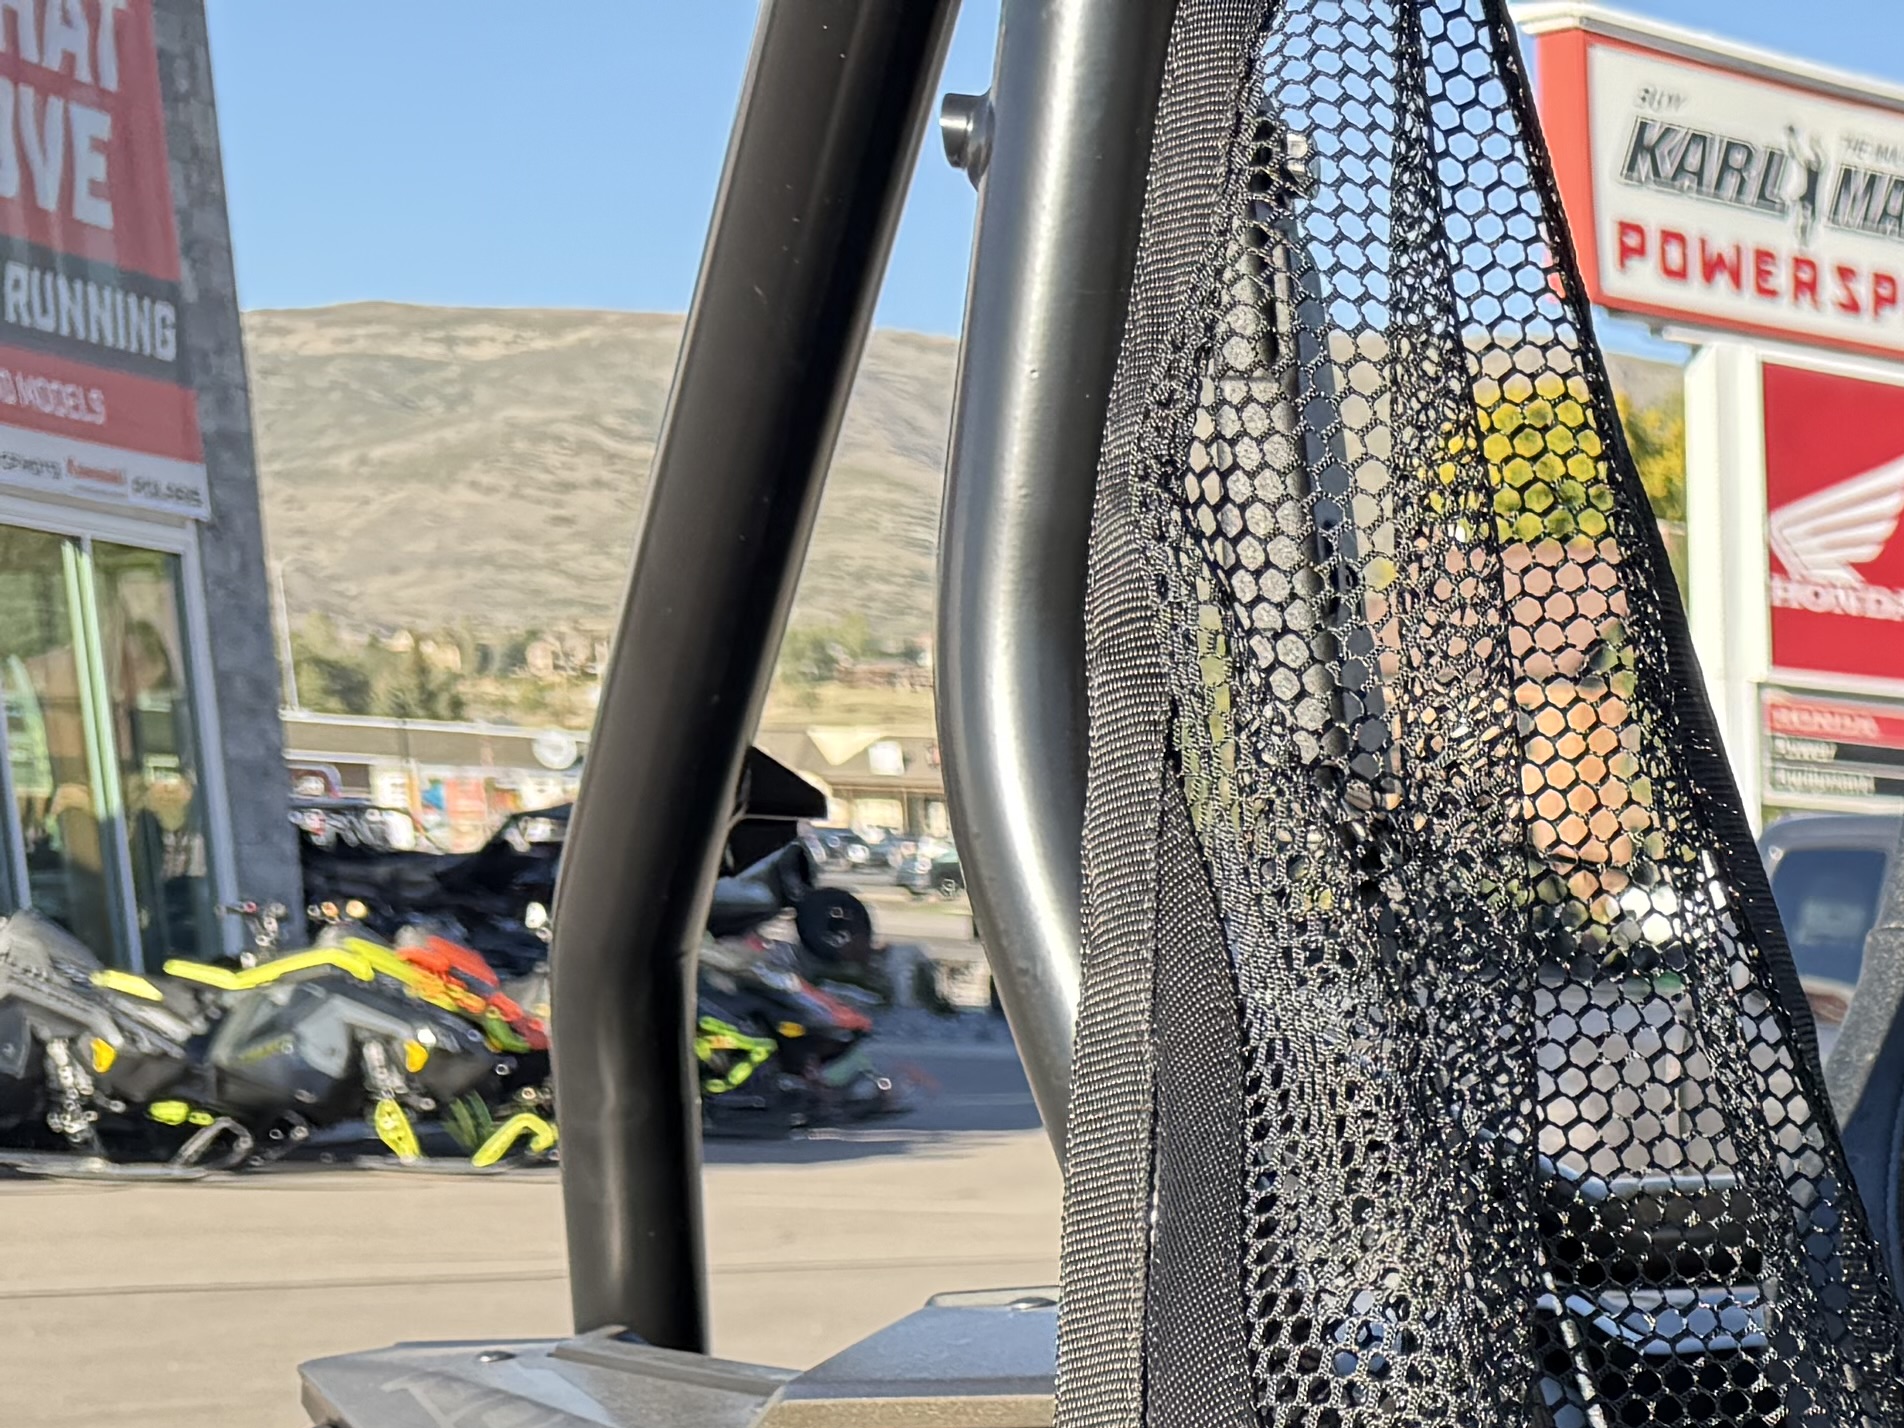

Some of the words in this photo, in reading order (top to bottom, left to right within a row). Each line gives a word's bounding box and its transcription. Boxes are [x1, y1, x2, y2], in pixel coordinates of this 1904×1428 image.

[1621, 115, 1788, 216] KARL
[4, 260, 178, 362] RUNNING
[17, 371, 106, 426] MODELS
